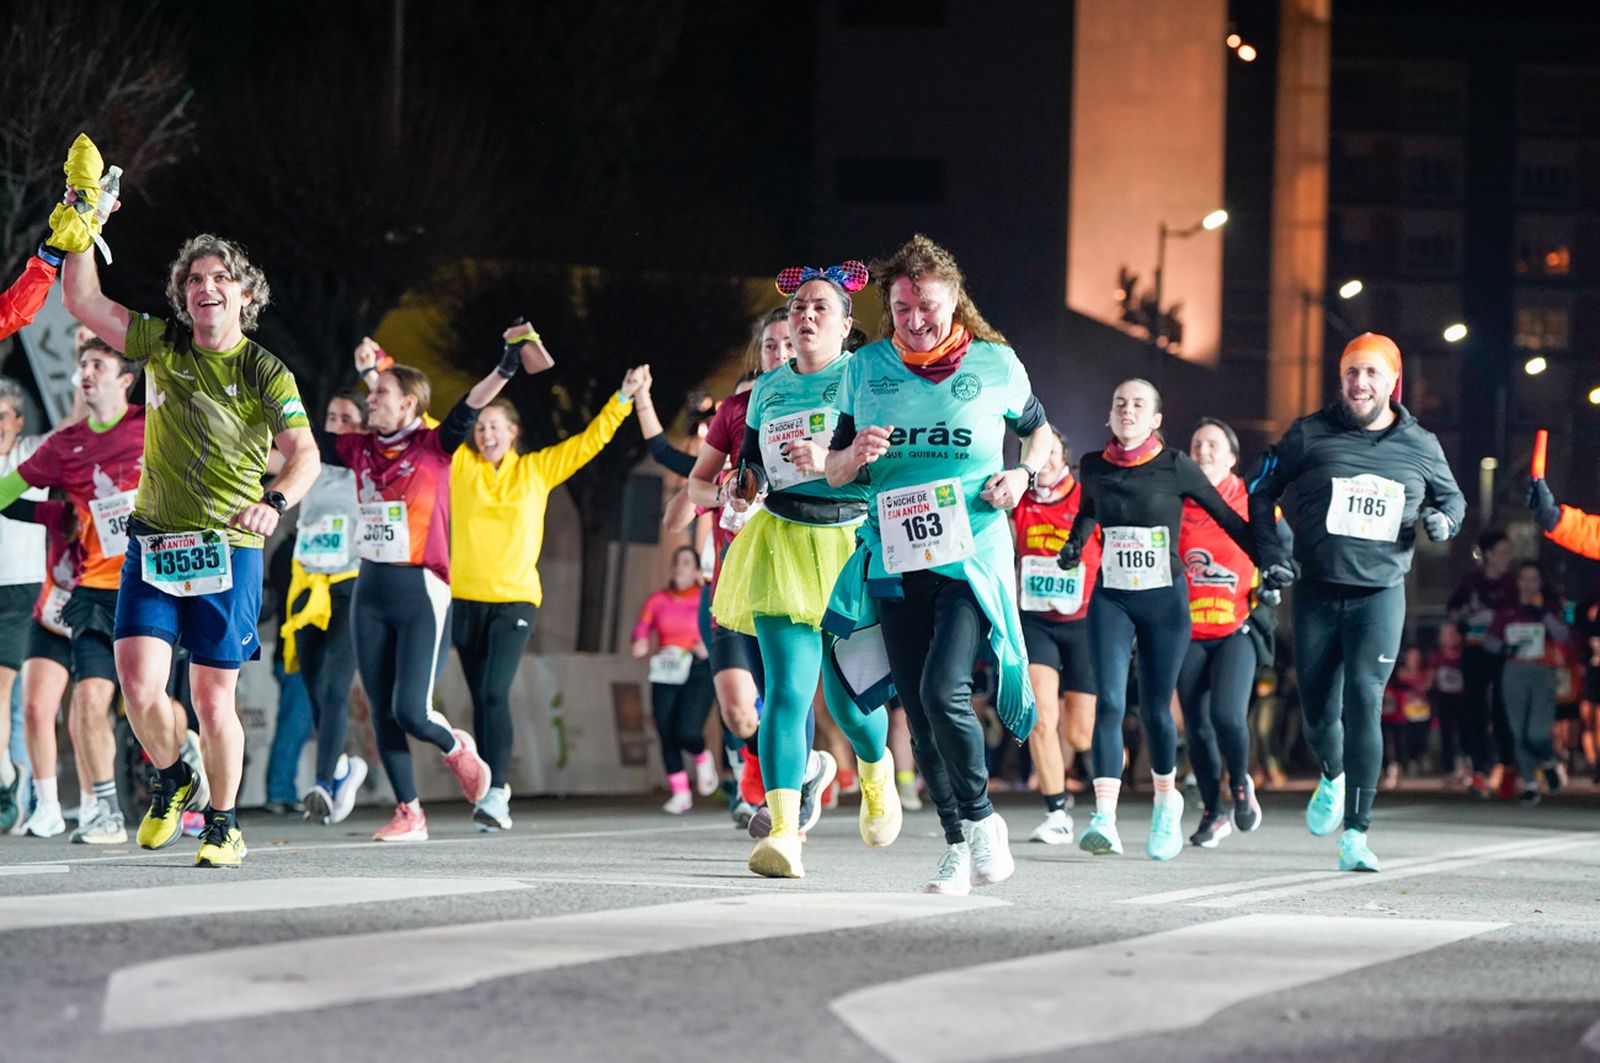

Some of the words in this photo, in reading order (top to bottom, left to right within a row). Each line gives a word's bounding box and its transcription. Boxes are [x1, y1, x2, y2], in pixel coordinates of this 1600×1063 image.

[888, 421, 972, 447] erás
[909, 451, 949, 459] QUIERAS
[893, 495, 917, 507] NOCHE
[917, 492, 928, 502] DE
[1348, 495, 1386, 517] 1185
[888, 509, 901, 520] SAN
[901, 512, 943, 542] 163
[152, 547, 220, 575] 13535
[1116, 550, 1155, 568] 1186
